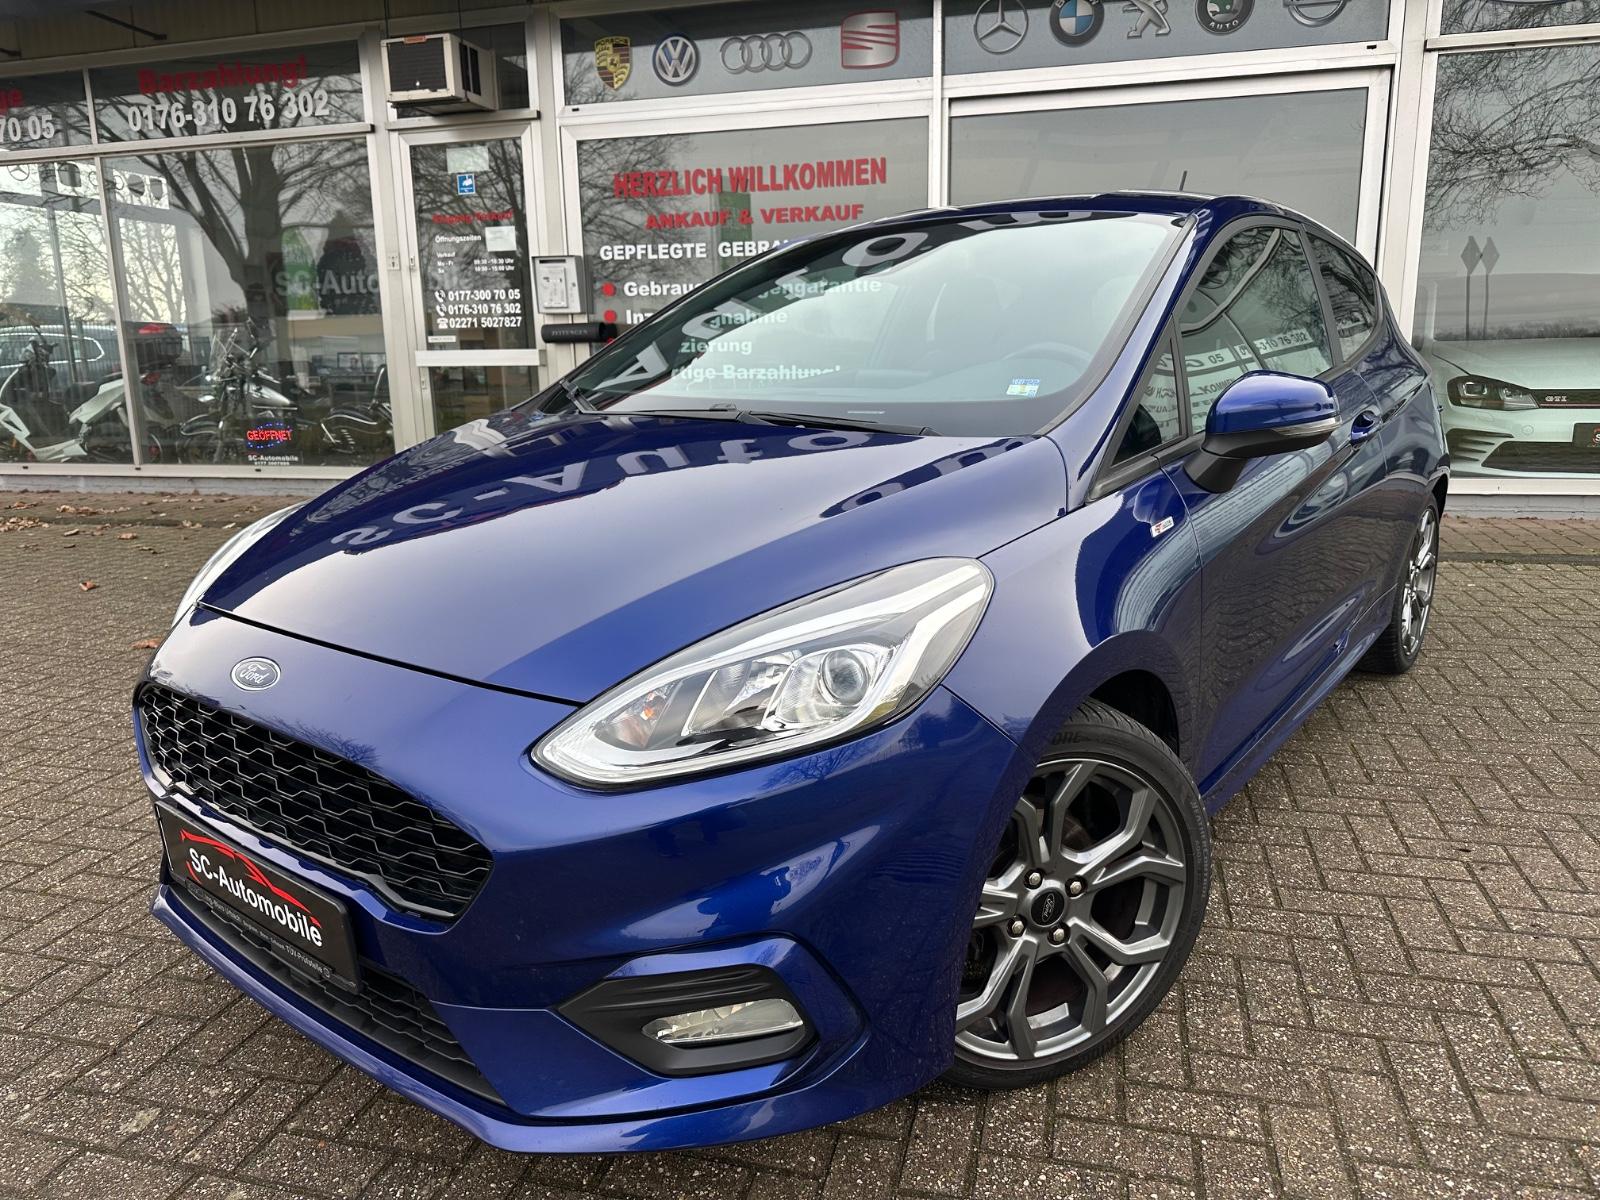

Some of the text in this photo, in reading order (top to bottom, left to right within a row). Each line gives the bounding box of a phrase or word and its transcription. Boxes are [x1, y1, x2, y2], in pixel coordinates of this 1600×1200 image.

[1210, 19, 1239, 30] AUTO
[137, 56, 307, 95] Barzahlung!
[128, 89, 330, 132] 0176-310 76 302
[27, 113, 55, 139] 05
[613, 157, 887, 199] HERZLICH WILLKOMMEN
[644, 204, 865, 230] ANKAUF & VERKAUF
[600, 243, 707, 261] GEPFLEGTE
[447, 288, 521, 302] 0177-300 70 05
[447, 302, 522, 315] 0176-310 76 302
[449, 316, 522, 329] 02271 5027827
[246, 429, 292, 441] GEÖFFNET
[239, 662, 270, 685] Ford
[188, 847, 323, 948] SC-Automobile
